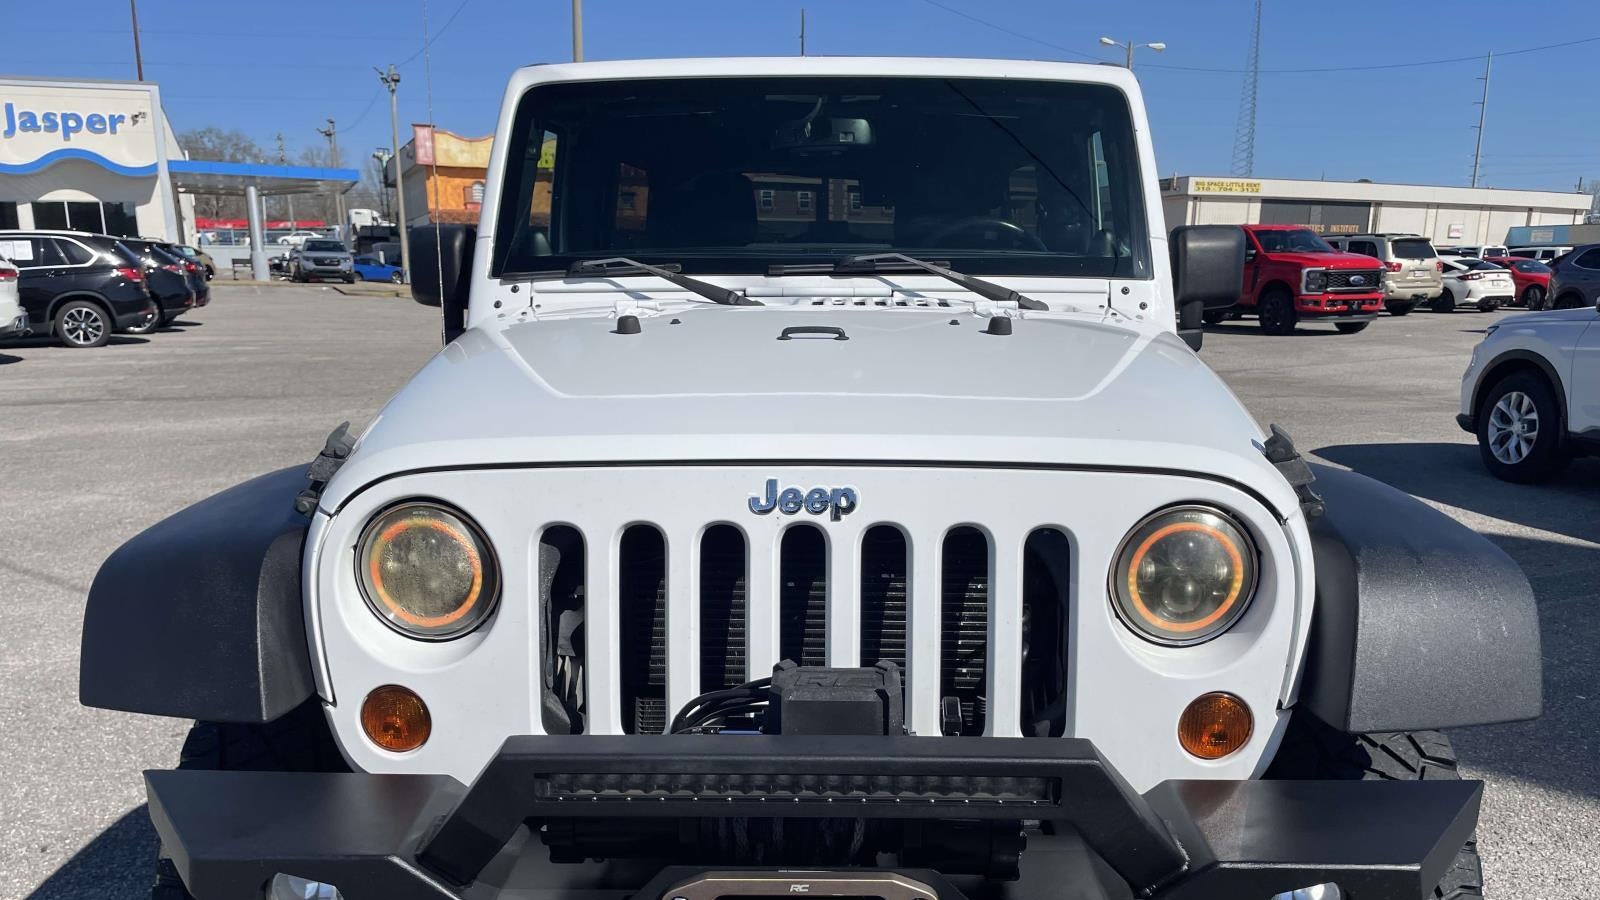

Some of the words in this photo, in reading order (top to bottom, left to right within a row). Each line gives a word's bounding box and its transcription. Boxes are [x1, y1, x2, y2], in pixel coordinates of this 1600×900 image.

[3, 102, 125, 141] Jasper
[748, 478, 857, 522] Jeep
[789, 884, 810, 892] RC
